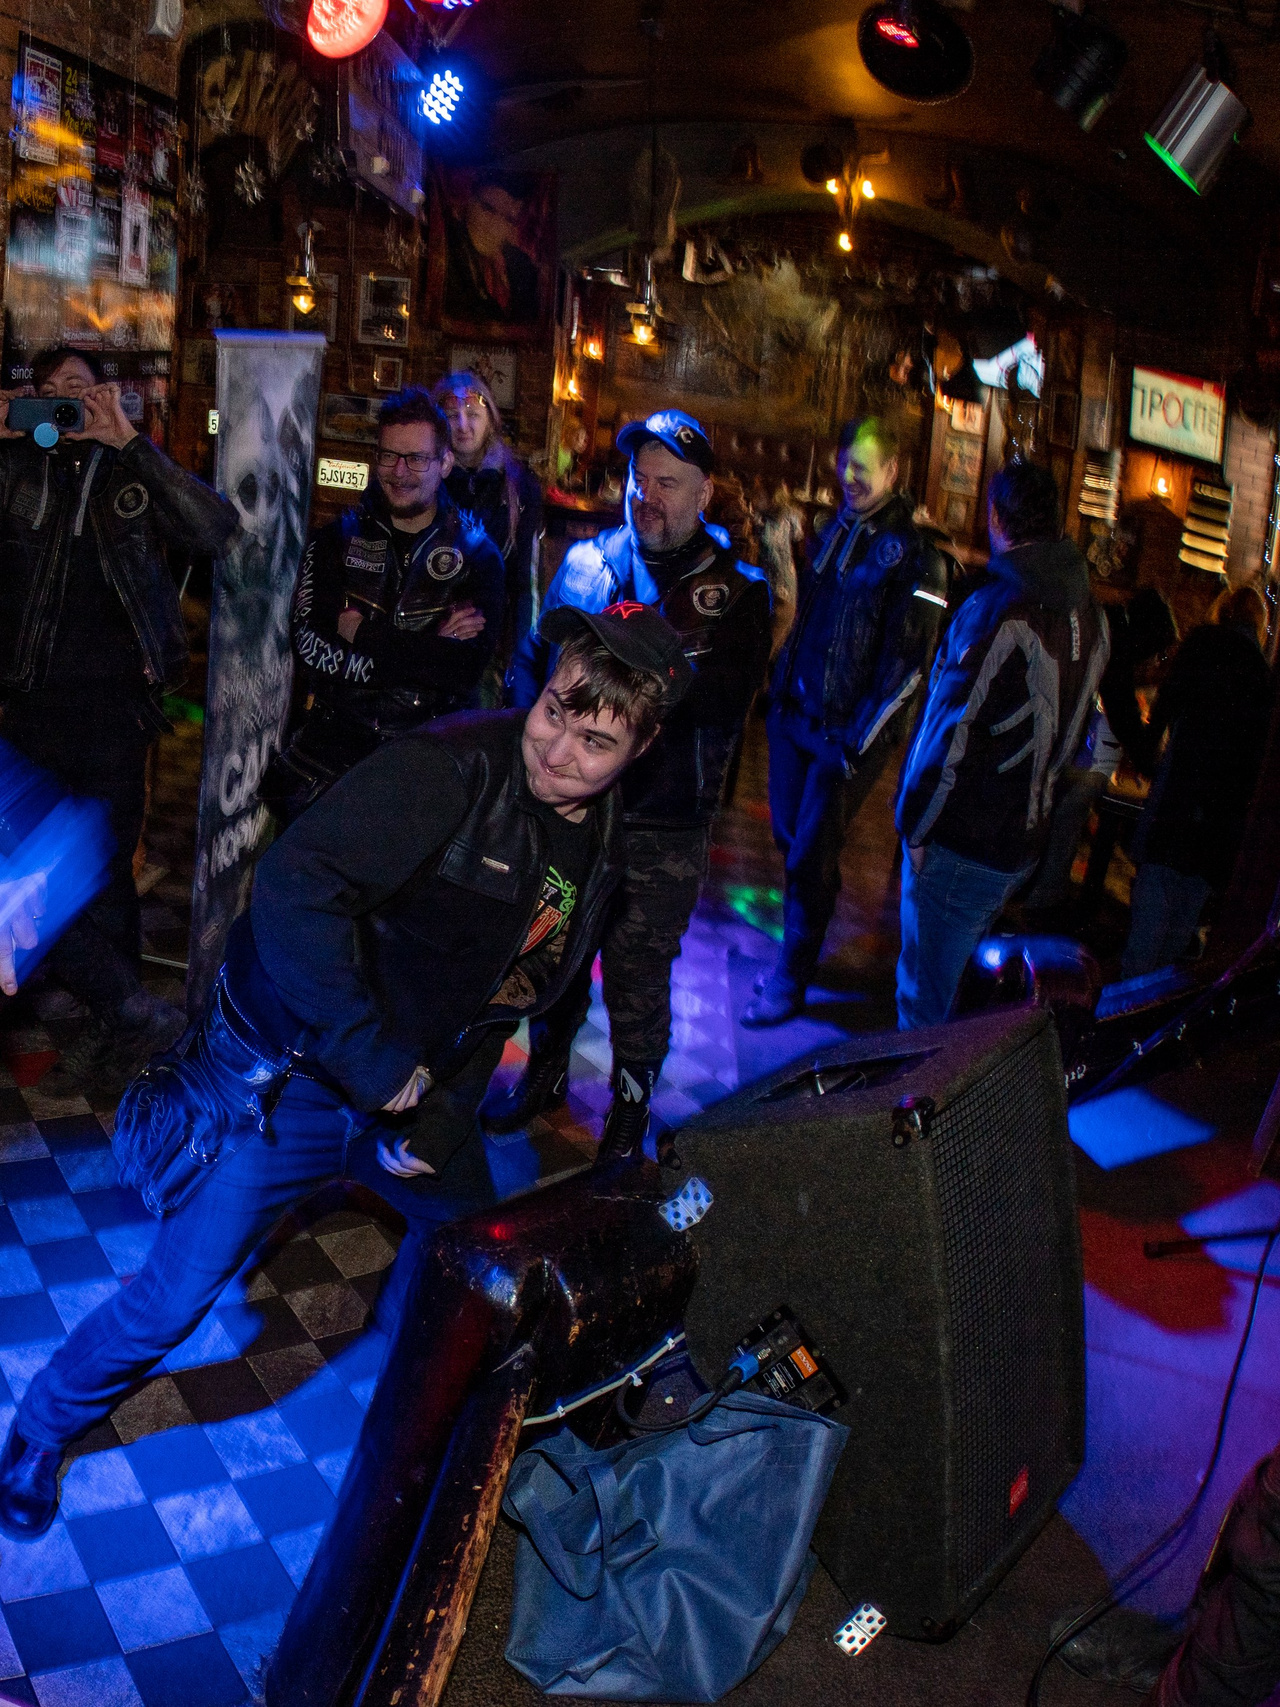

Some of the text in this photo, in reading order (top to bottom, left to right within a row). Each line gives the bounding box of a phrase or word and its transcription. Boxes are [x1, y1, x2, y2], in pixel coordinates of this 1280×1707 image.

[11, 365, 35, 380] since
[103, 362, 119, 376] 1993
[320, 468, 365, 487] 5JSV357
[344, 653, 375, 683] MC
